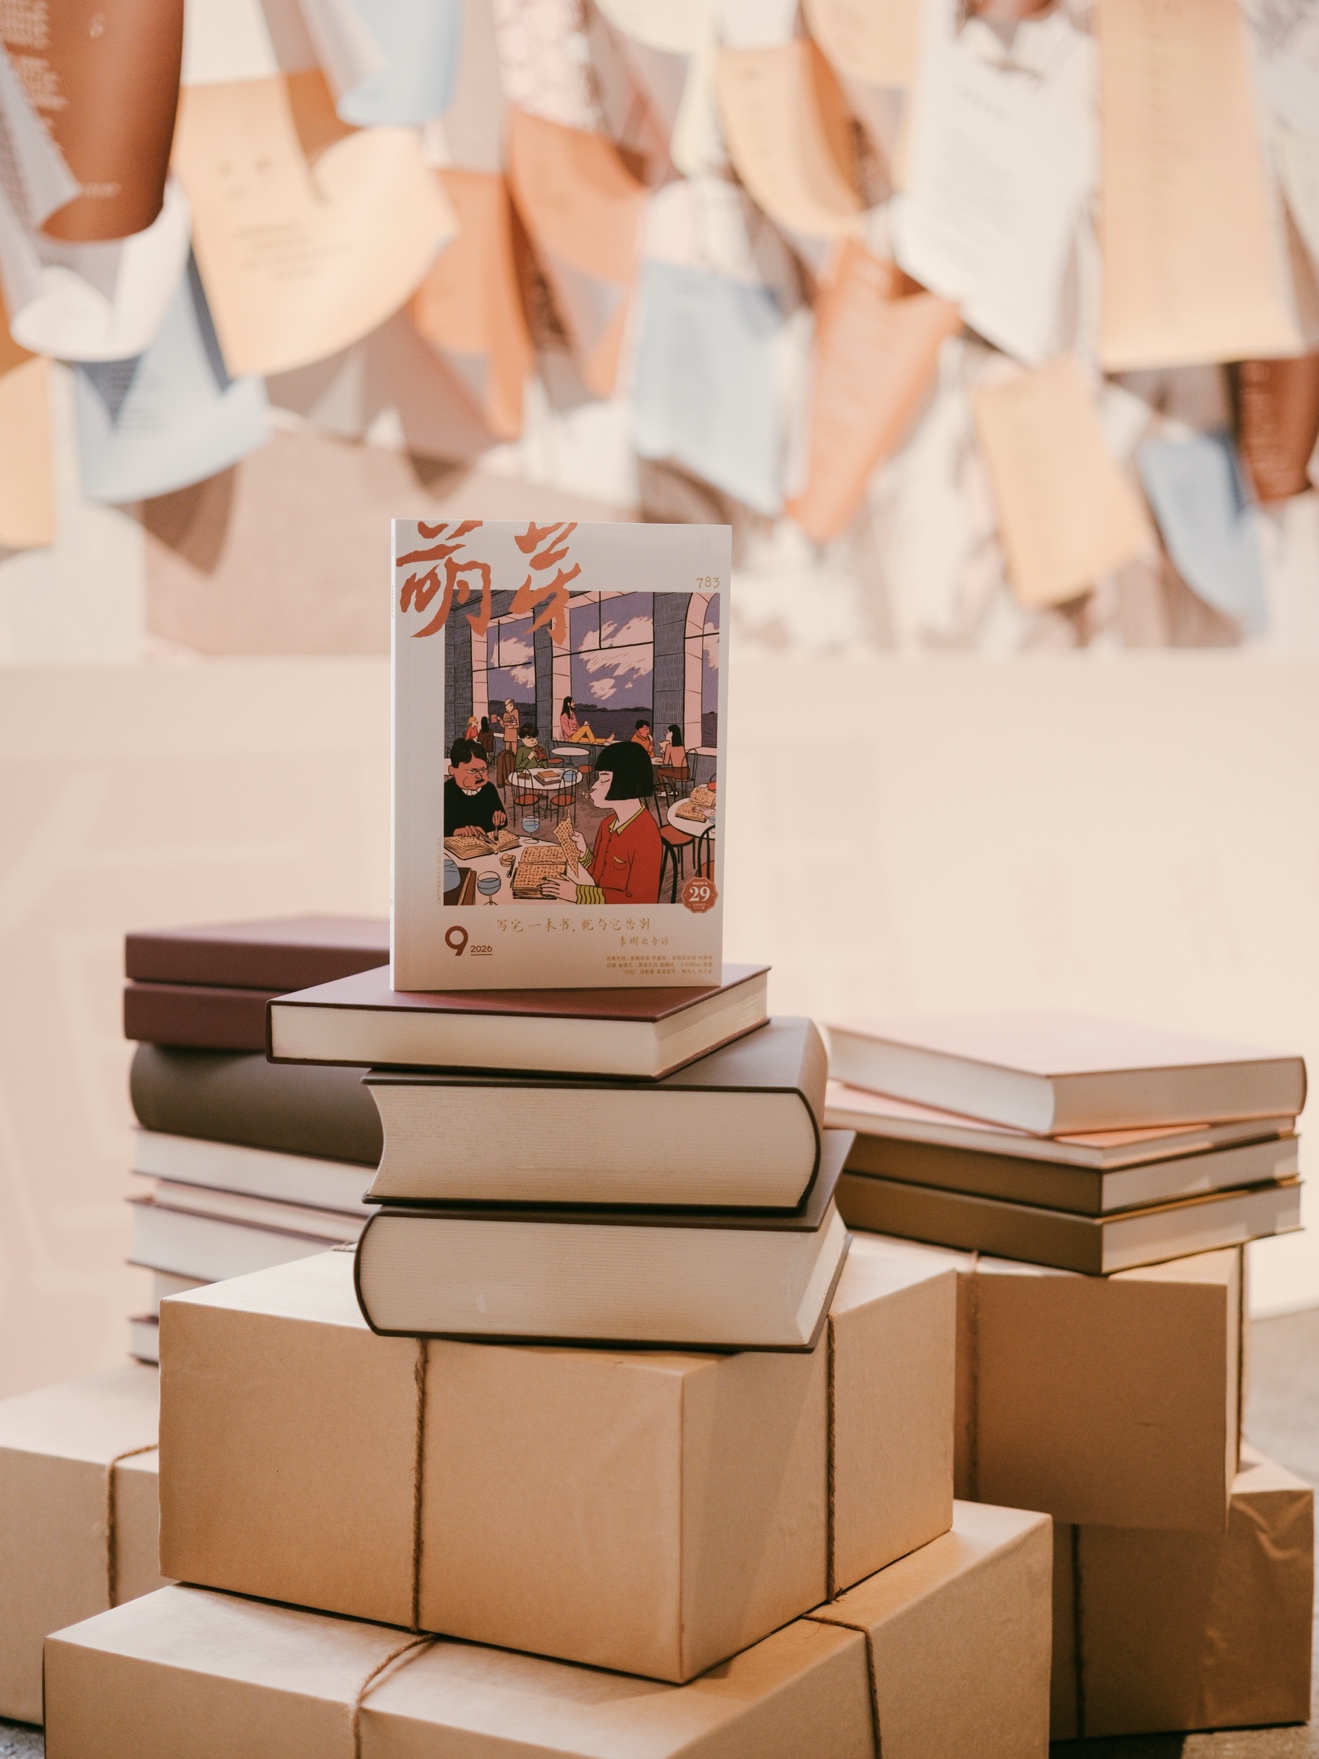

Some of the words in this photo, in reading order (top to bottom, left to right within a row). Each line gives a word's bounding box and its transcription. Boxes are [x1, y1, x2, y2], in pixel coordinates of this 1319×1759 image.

[396, 520, 582, 645] 萌芽
[696, 576, 720, 589] 783
[688, 886, 711, 902] 29
[445, 925, 469, 956] 9
[470, 945, 493, 953] 2026
